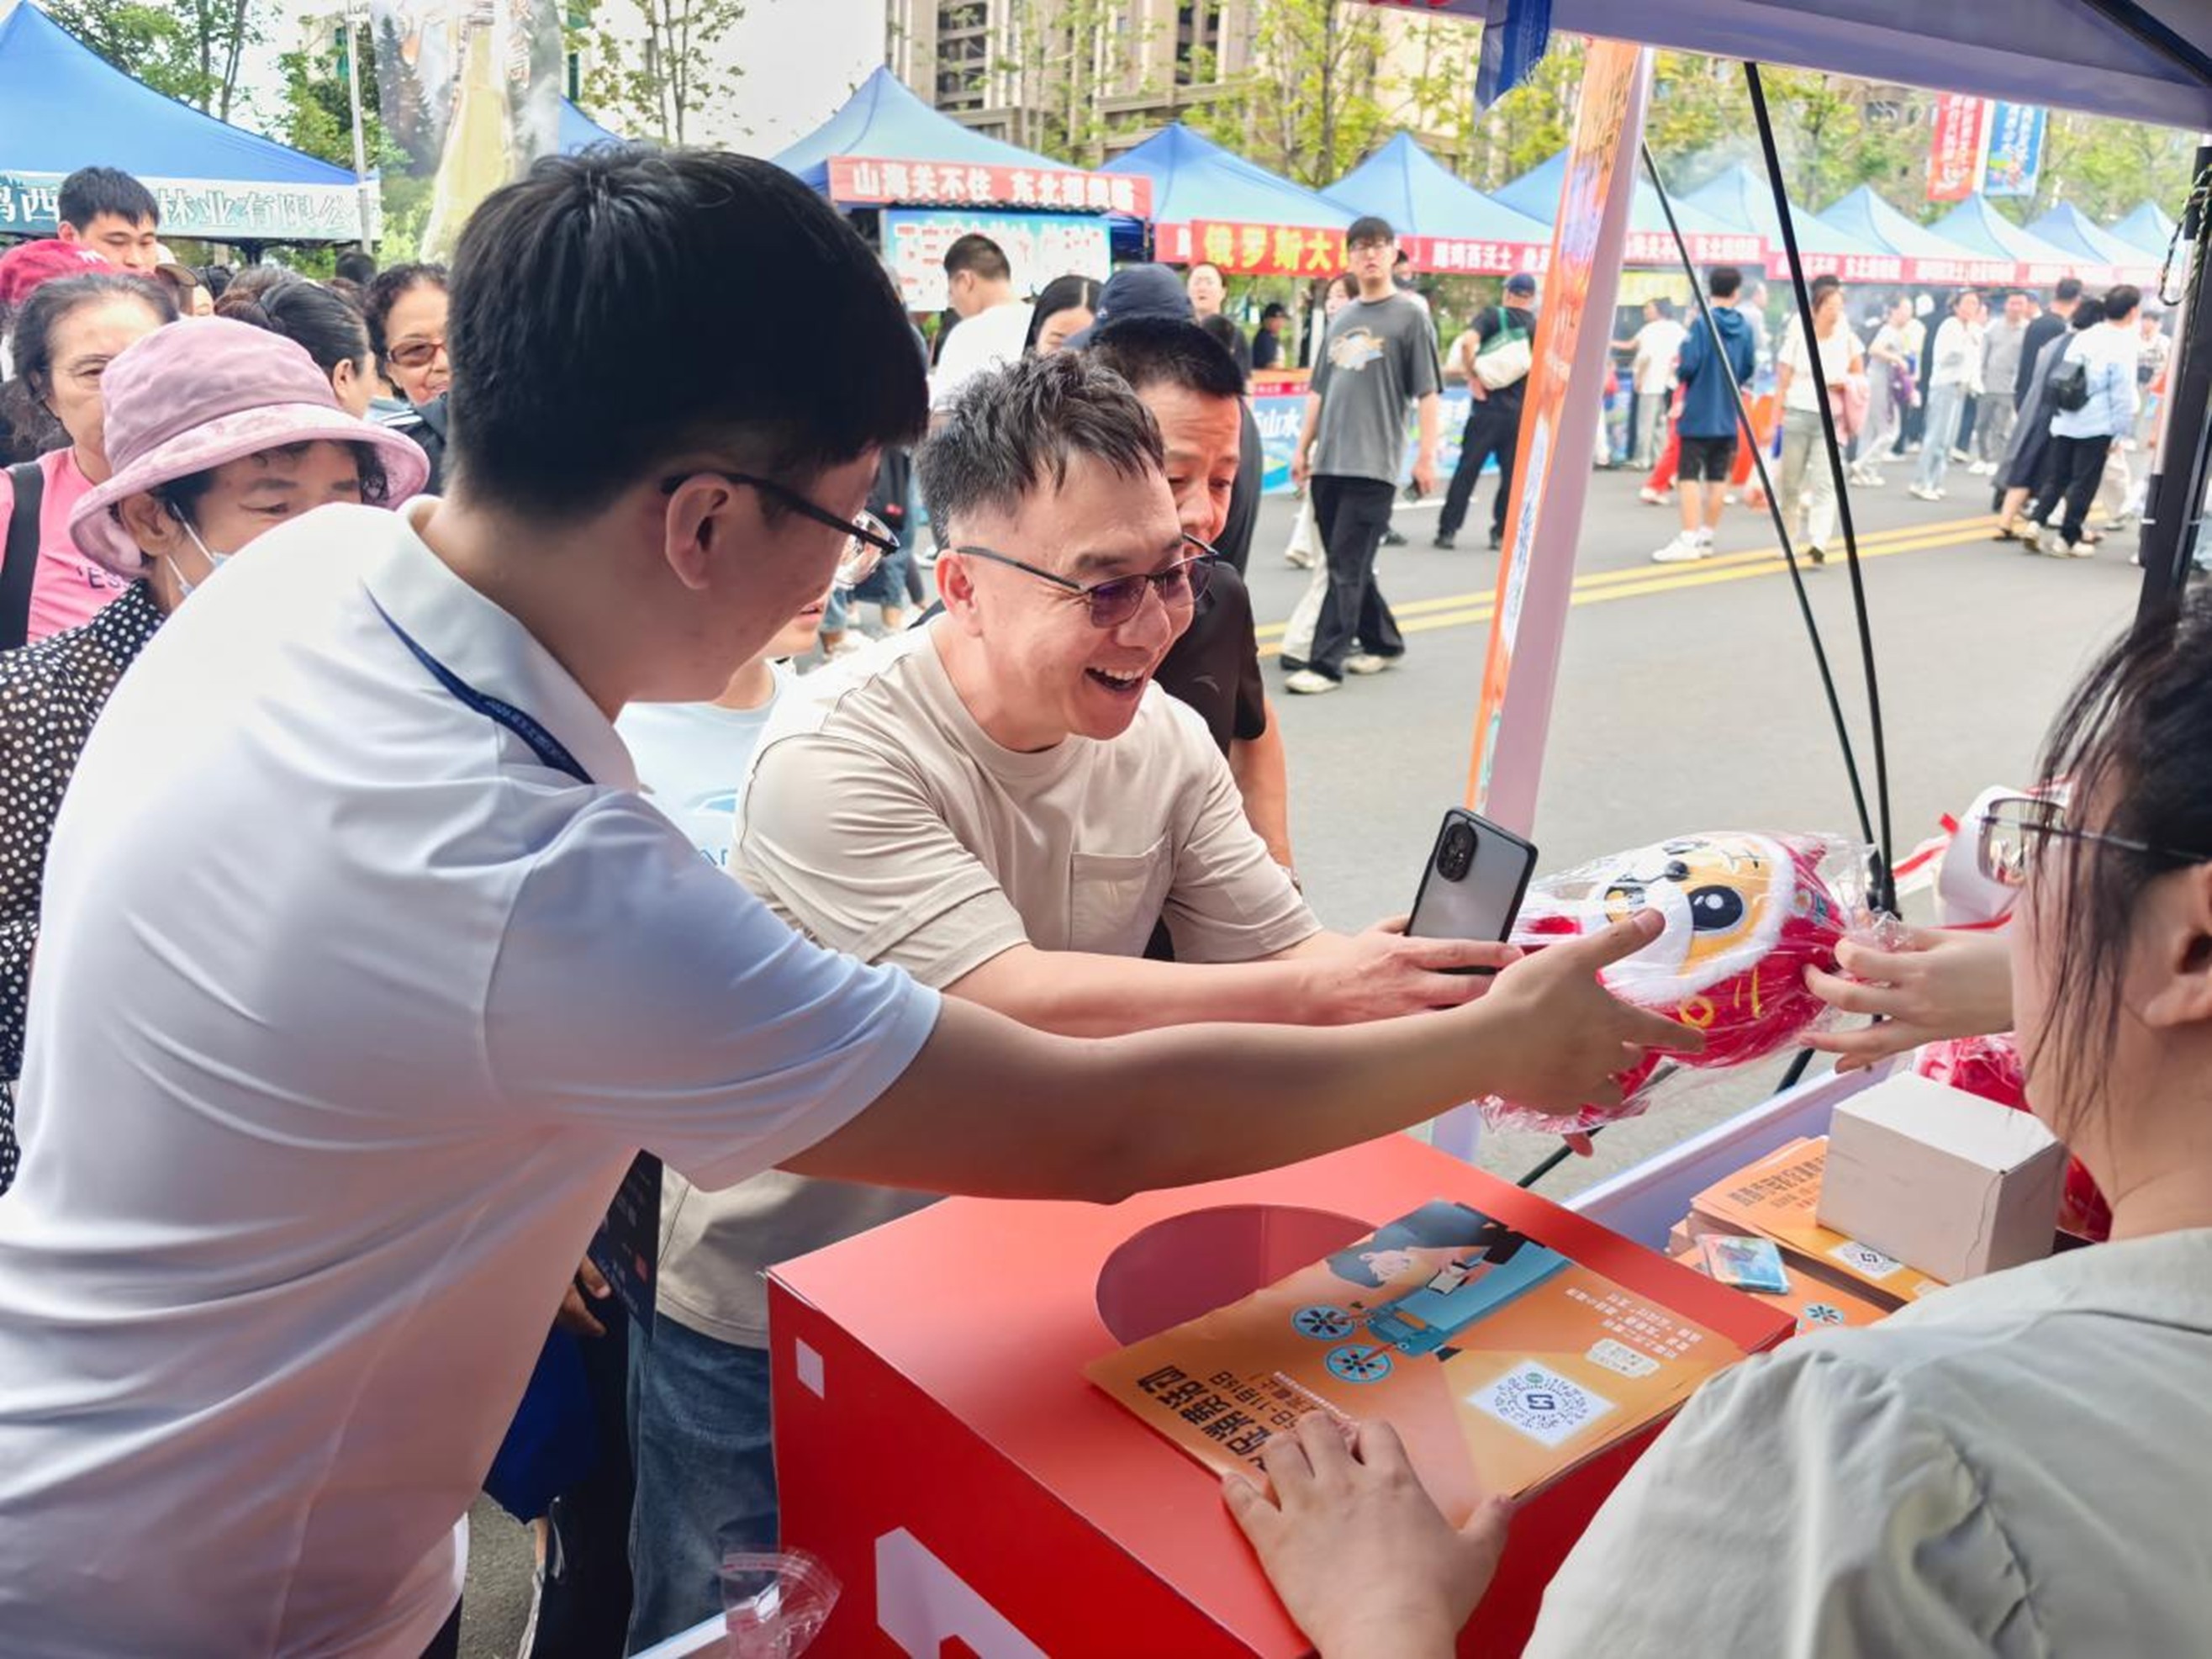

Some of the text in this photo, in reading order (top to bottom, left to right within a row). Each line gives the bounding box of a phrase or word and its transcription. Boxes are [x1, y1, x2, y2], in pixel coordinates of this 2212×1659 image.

[1137, 1365, 1271, 1471] 促消费活动
